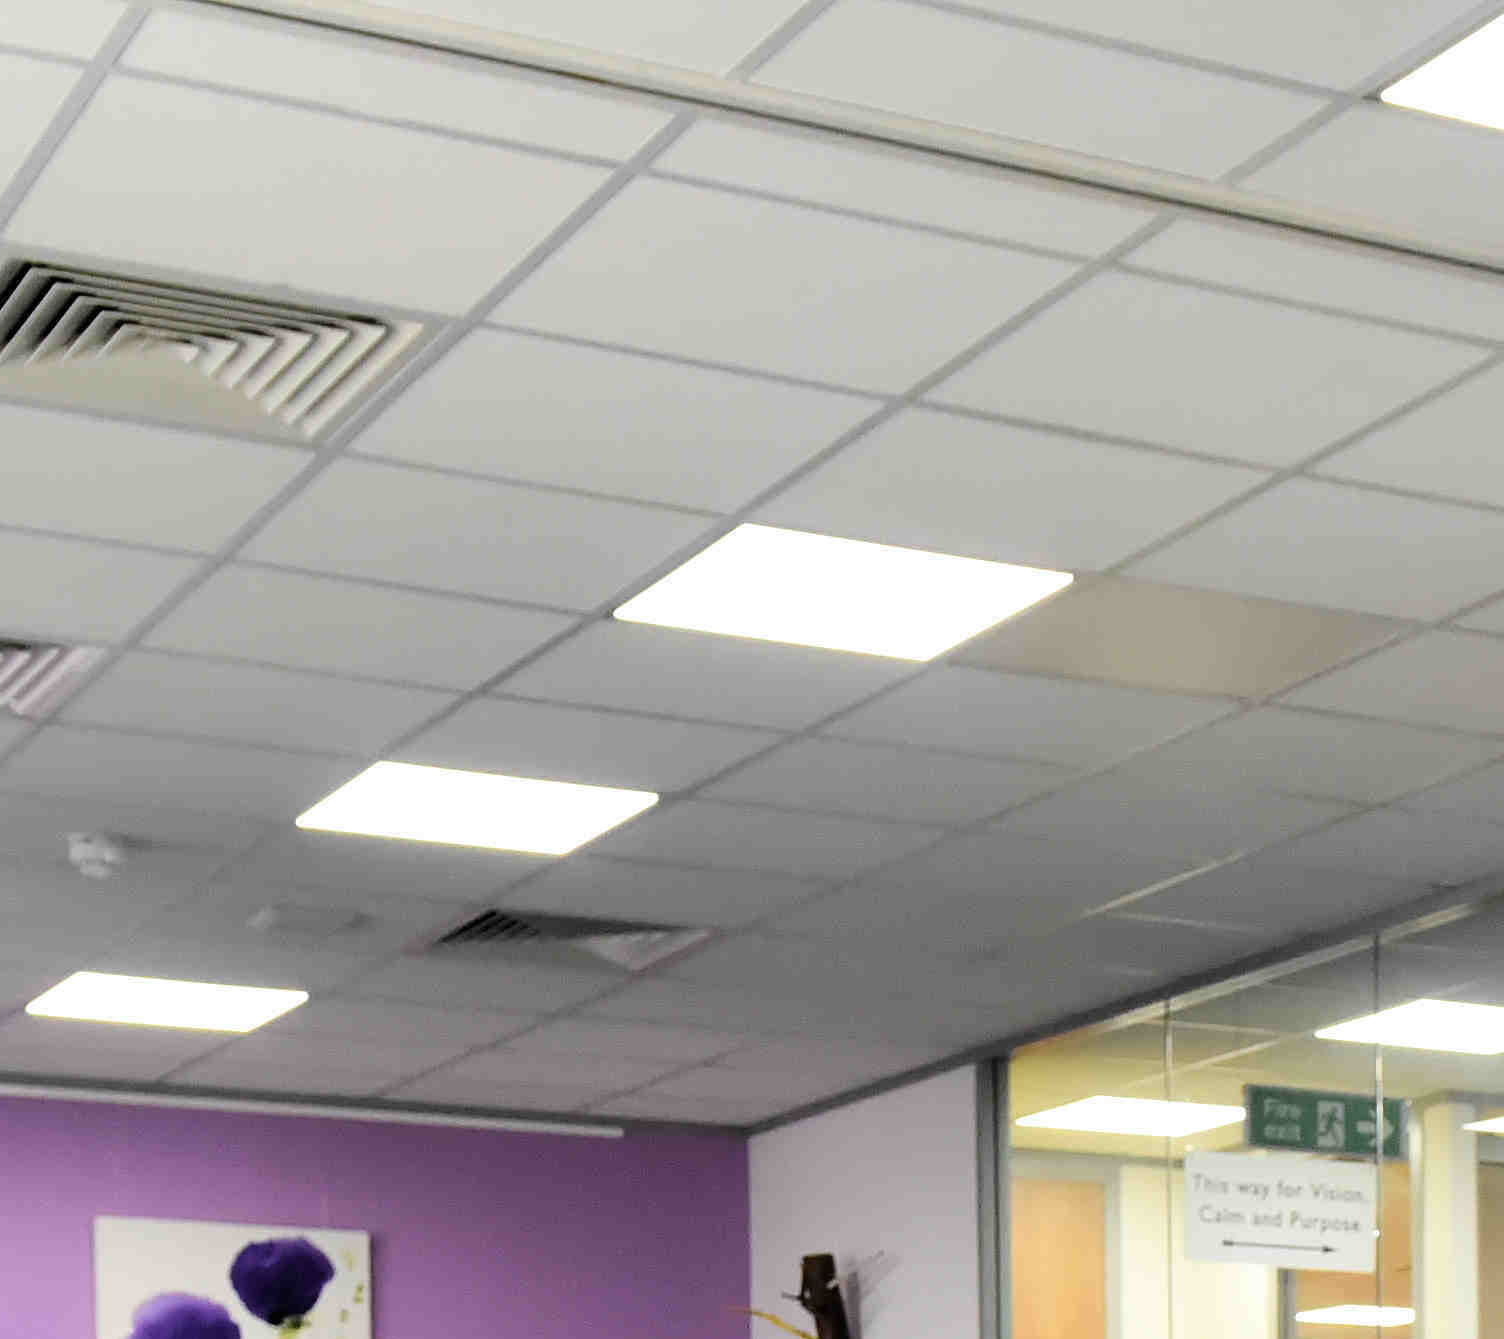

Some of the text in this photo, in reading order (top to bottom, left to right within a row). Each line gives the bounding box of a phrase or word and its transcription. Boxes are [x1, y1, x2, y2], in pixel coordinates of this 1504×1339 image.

[1263, 1099, 1300, 1118] Fire
[1264, 1124, 1300, 1141] exit
[1193, 1173, 1228, 1194] This
[1237, 1183, 1269, 1200] way
[1277, 1179, 1301, 1197] for
[1200, 1205, 1360, 1233] Calm and Purpose
